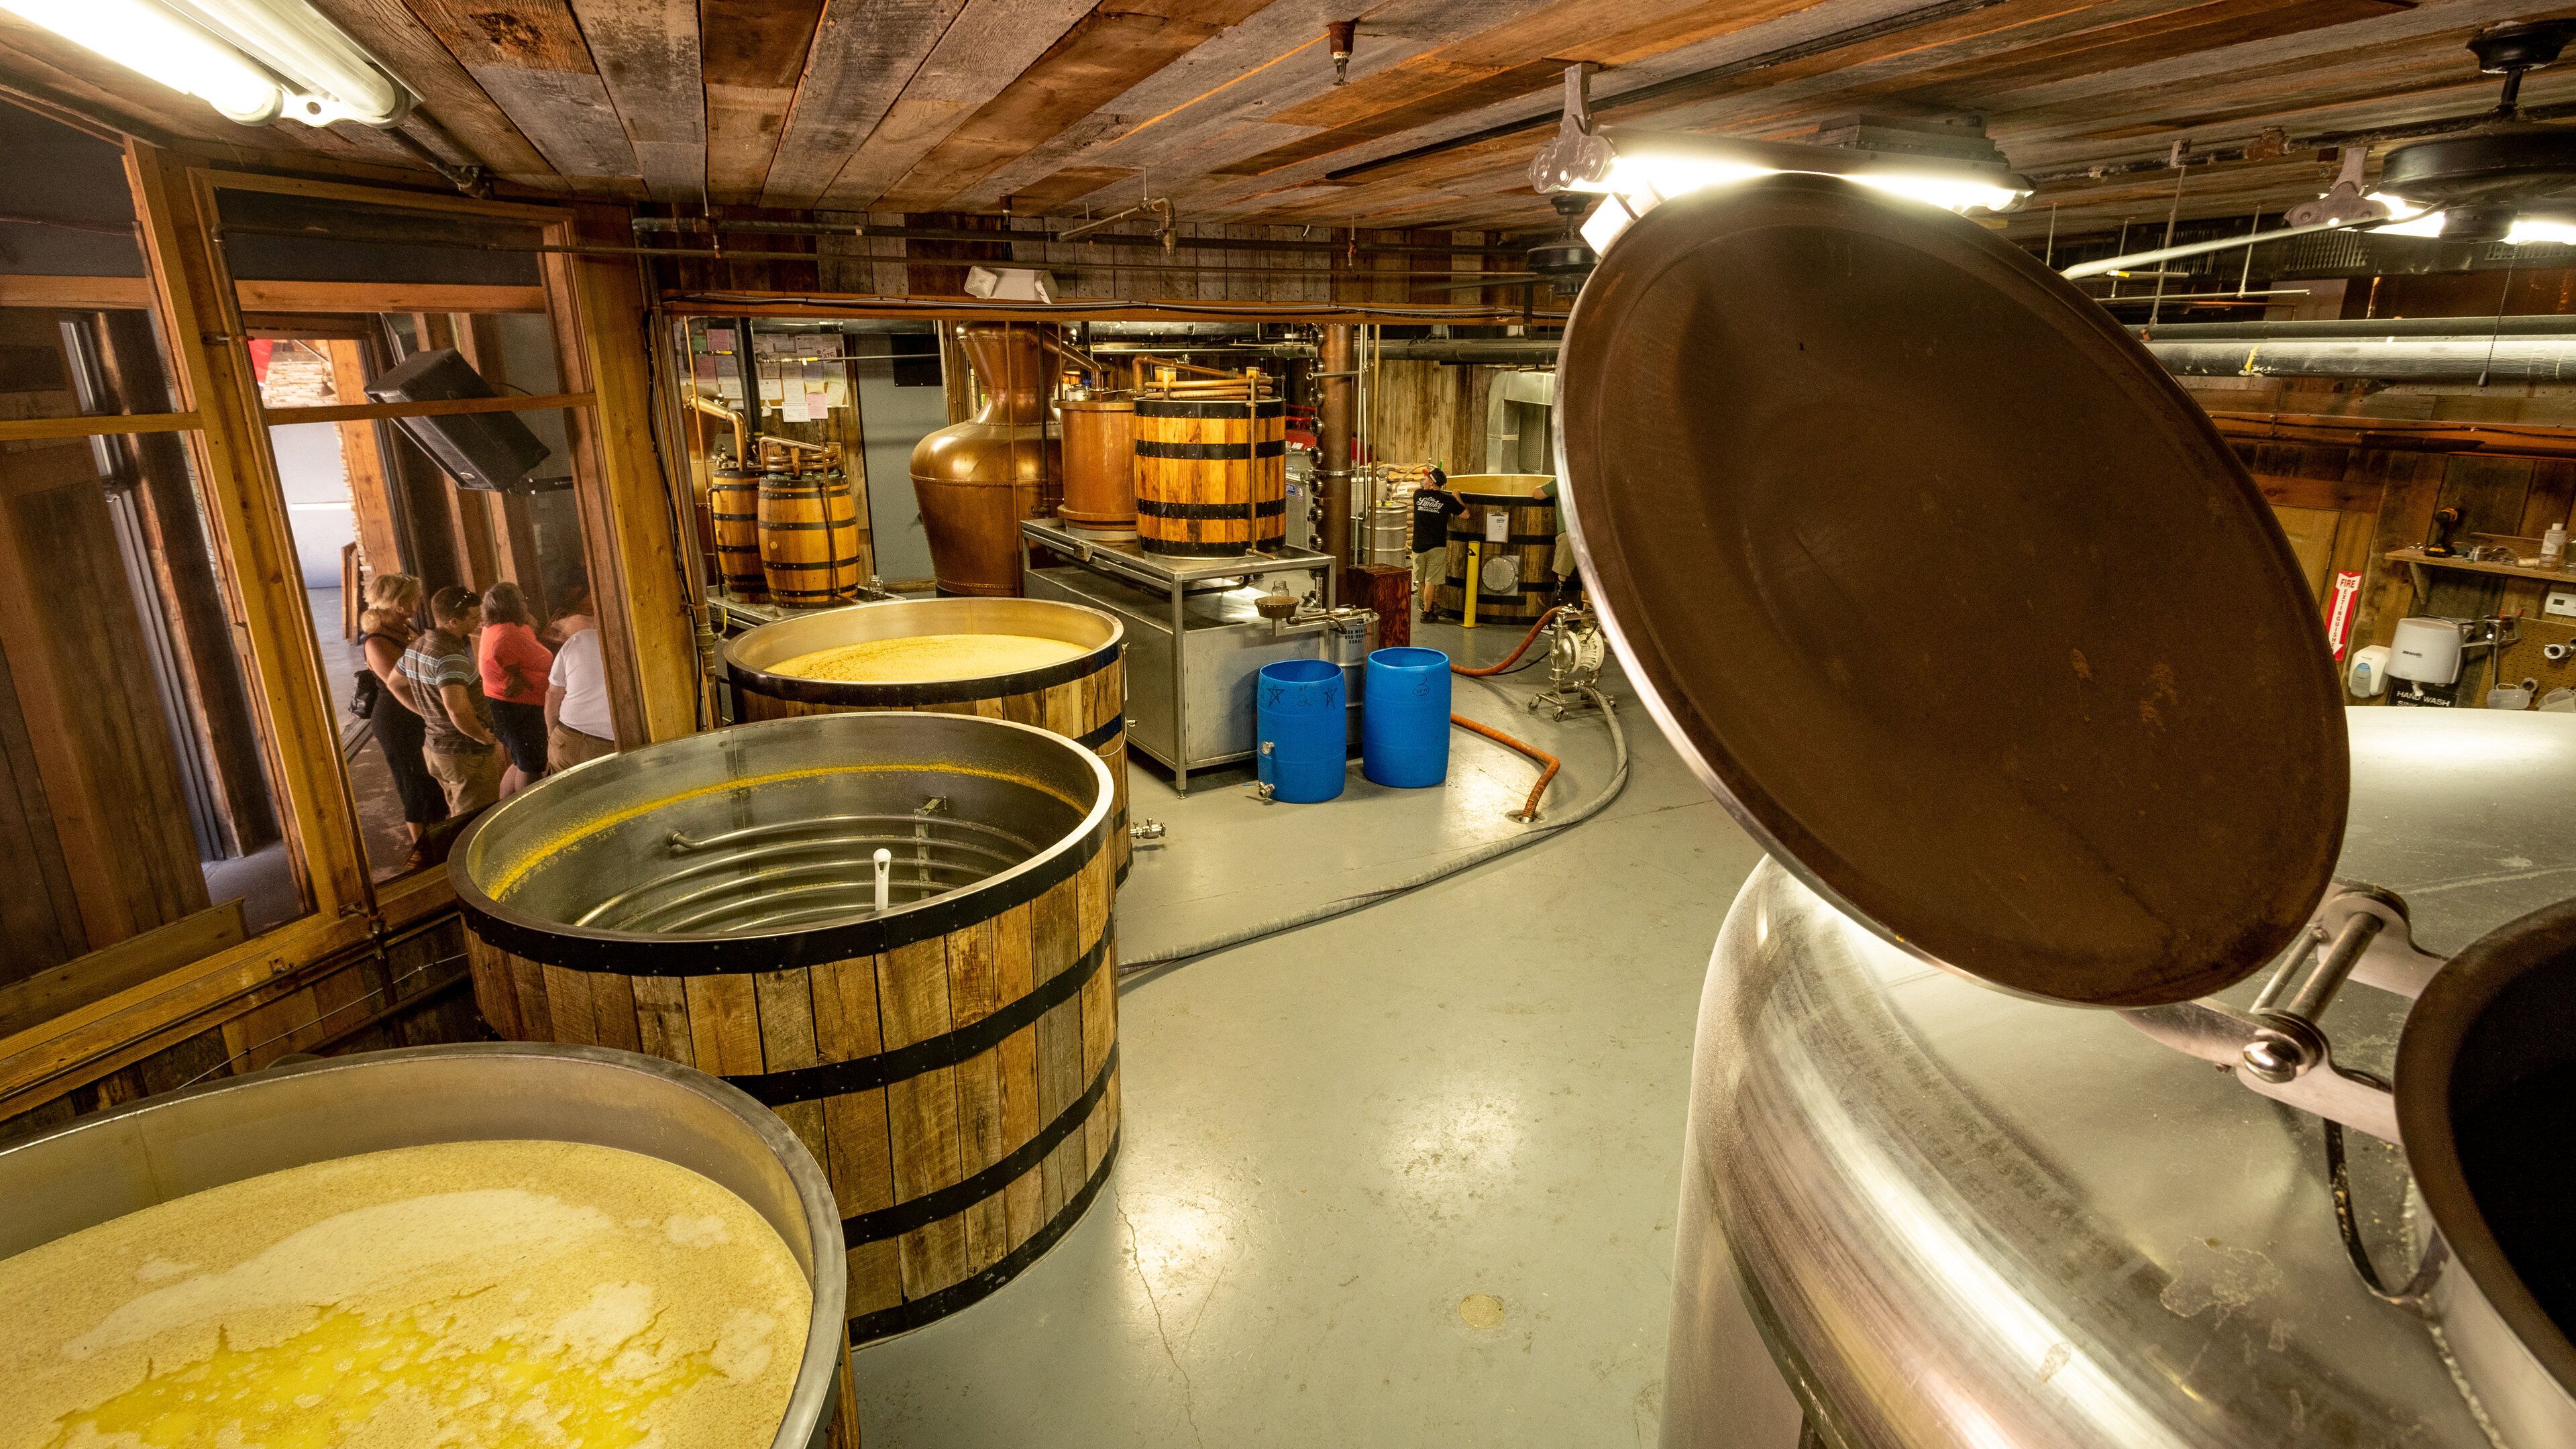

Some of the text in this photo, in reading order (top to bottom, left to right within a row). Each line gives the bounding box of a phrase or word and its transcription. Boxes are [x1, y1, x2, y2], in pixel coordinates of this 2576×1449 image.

[1416, 497, 1444, 510] Smoky
[2341, 579, 2356, 588] FIRE
[2330, 589, 2347, 651] EXTINGUISHE
[2397, 690, 2451, 706] HAND WASH
